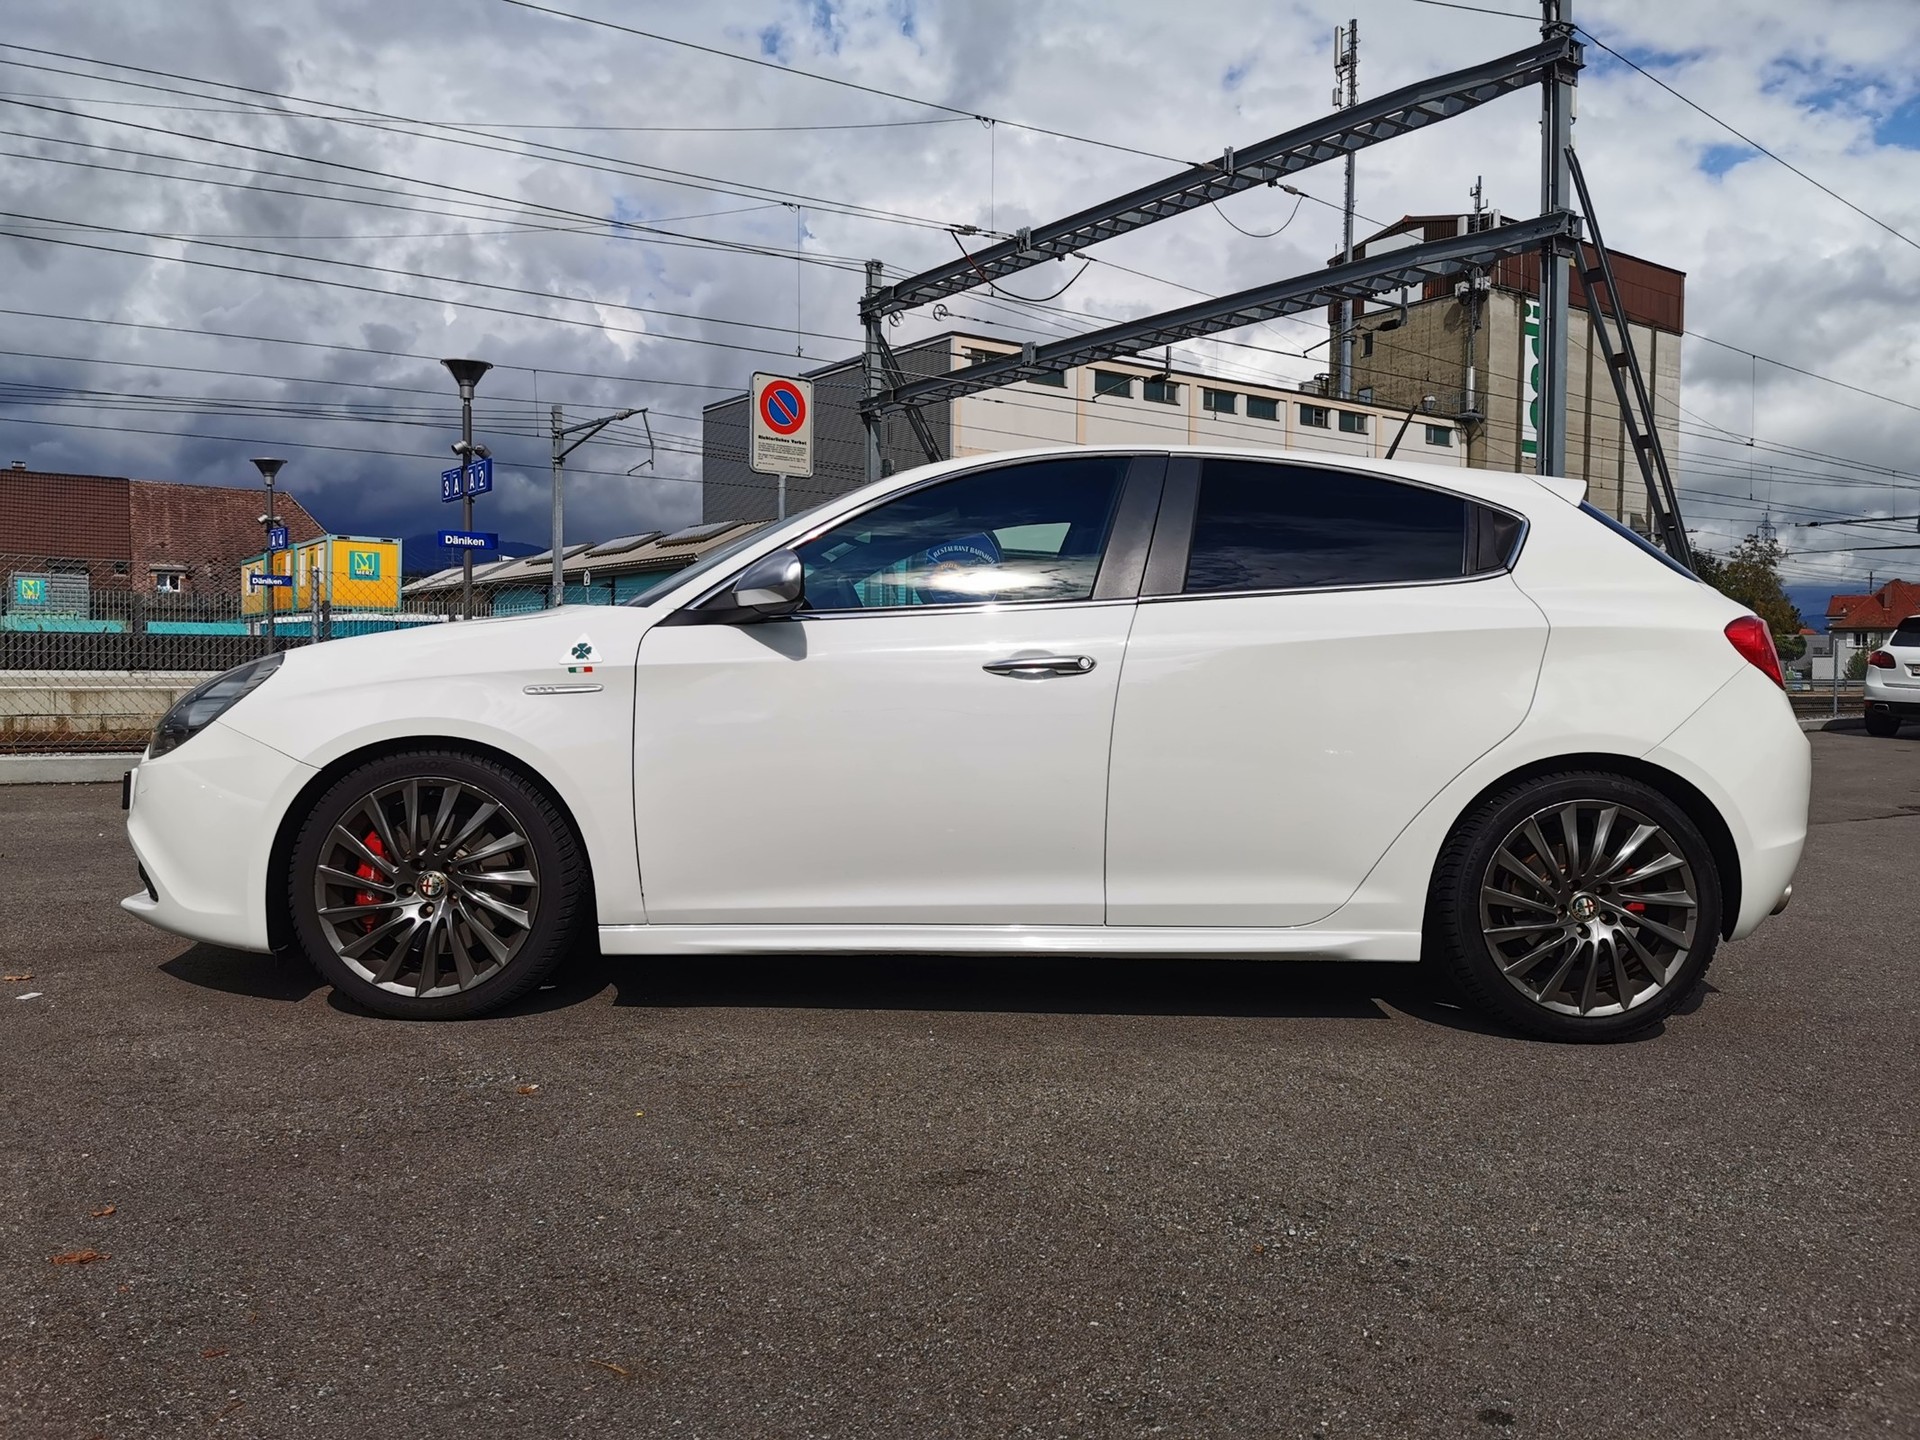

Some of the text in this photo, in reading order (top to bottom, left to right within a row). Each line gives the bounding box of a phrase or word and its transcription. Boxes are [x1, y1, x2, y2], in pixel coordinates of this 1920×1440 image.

[469, 470, 485, 490] A 2
[444, 478, 459, 497] 3 A
[445, 535, 485, 547] Däniken
[933, 545, 969, 558] RESTAURANT
[252, 577, 283, 585] Däniken
